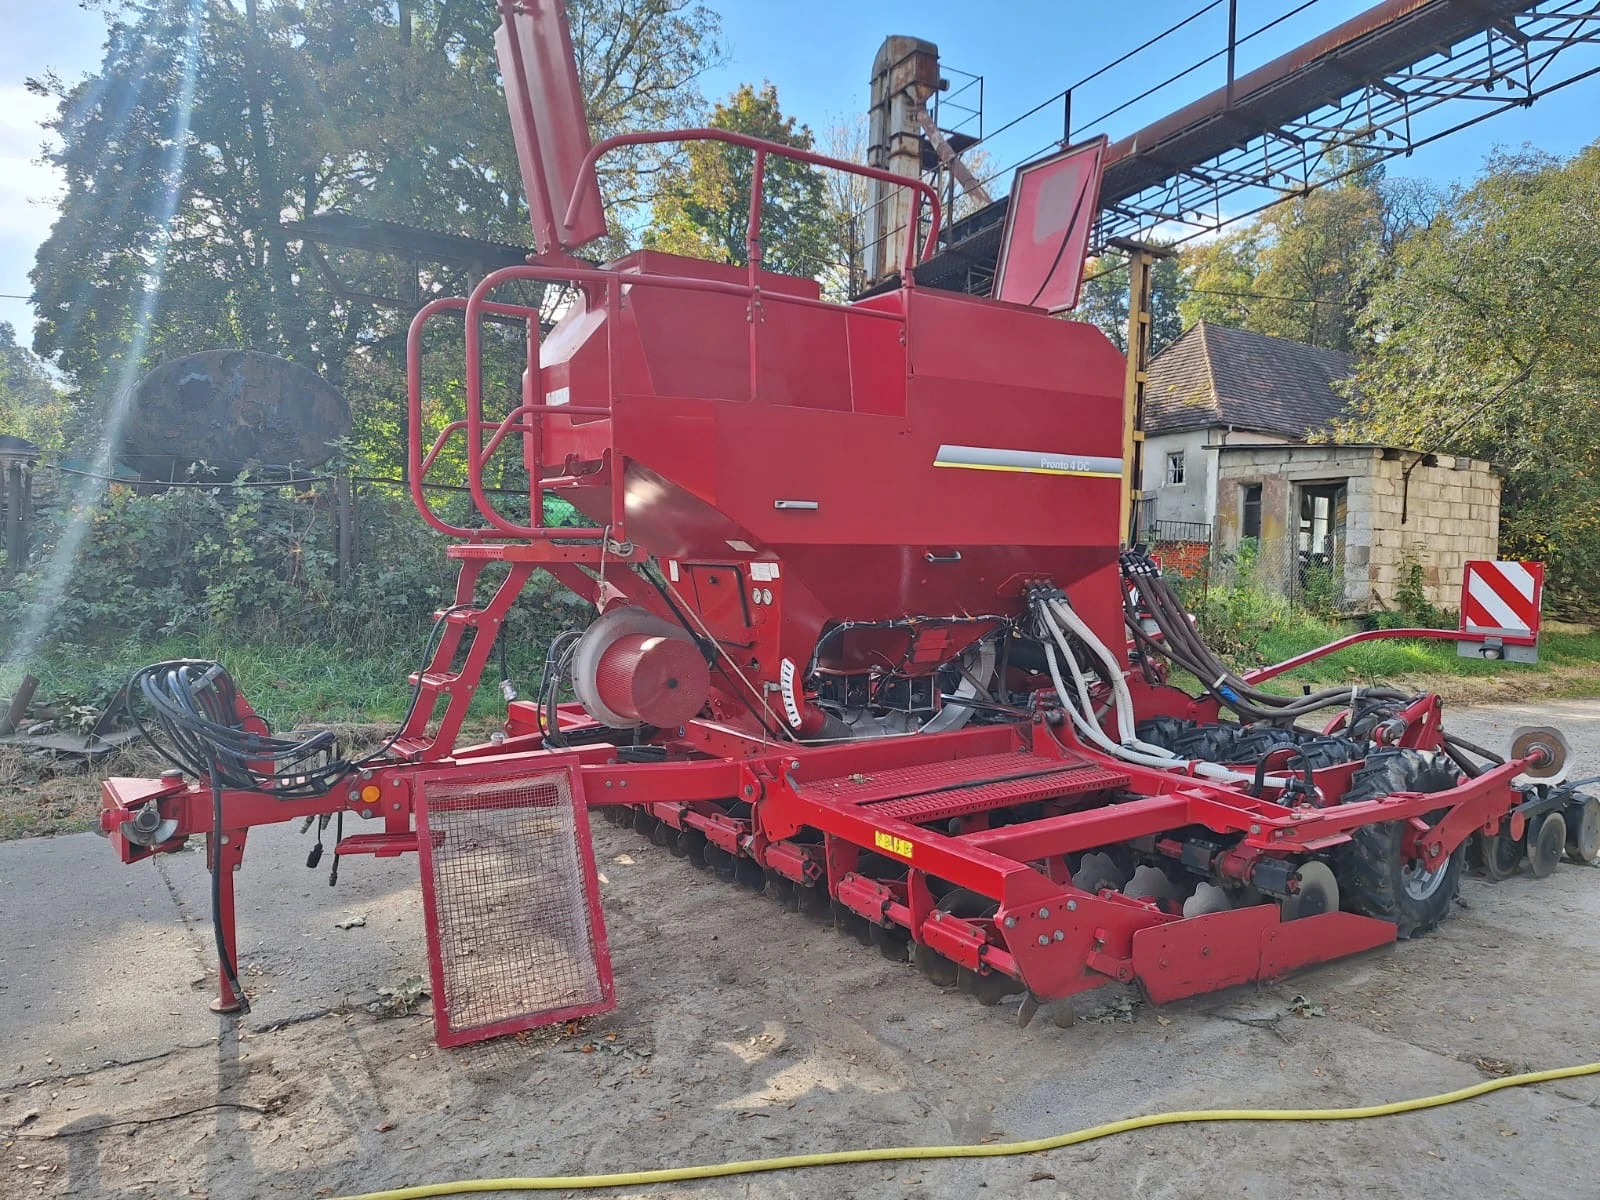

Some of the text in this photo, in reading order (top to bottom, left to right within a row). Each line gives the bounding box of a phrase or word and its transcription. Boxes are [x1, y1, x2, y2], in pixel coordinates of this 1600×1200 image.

[1041, 458, 1090, 471] Pronto 4 DC
